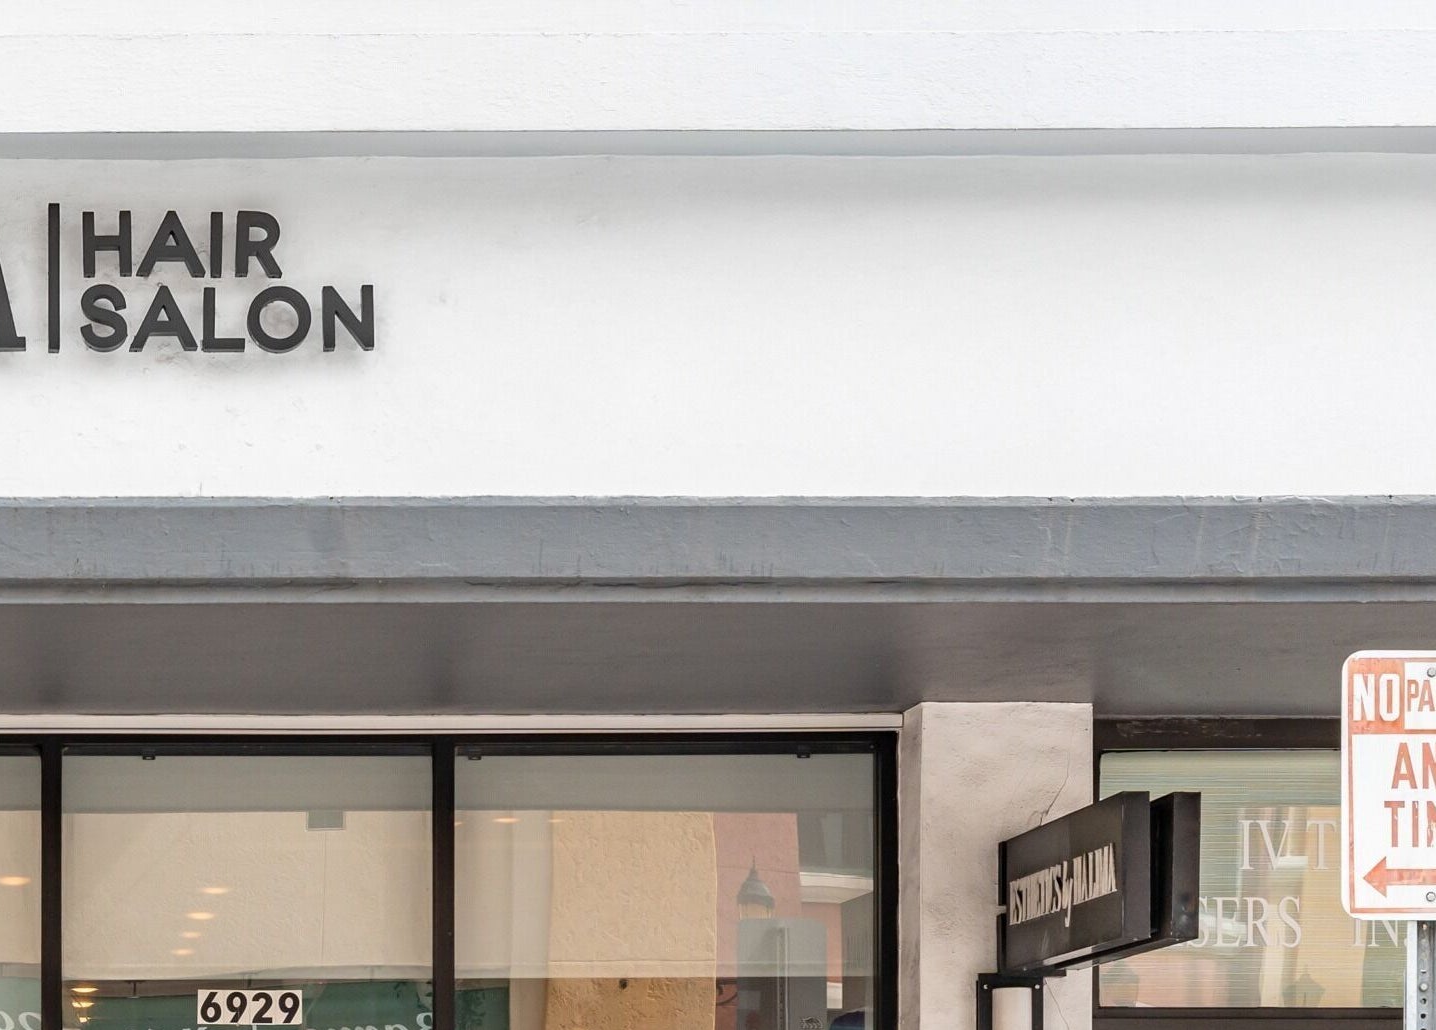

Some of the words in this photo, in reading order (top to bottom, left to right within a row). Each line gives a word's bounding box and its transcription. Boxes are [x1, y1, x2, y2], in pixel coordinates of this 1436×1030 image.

[81, 210, 282, 278] HAIR
[79, 284, 374, 353] SALON
[1353, 673, 1400, 721] NO
[1186, 896, 1303, 947] SERS
[200, 991, 300, 1024] 6929
